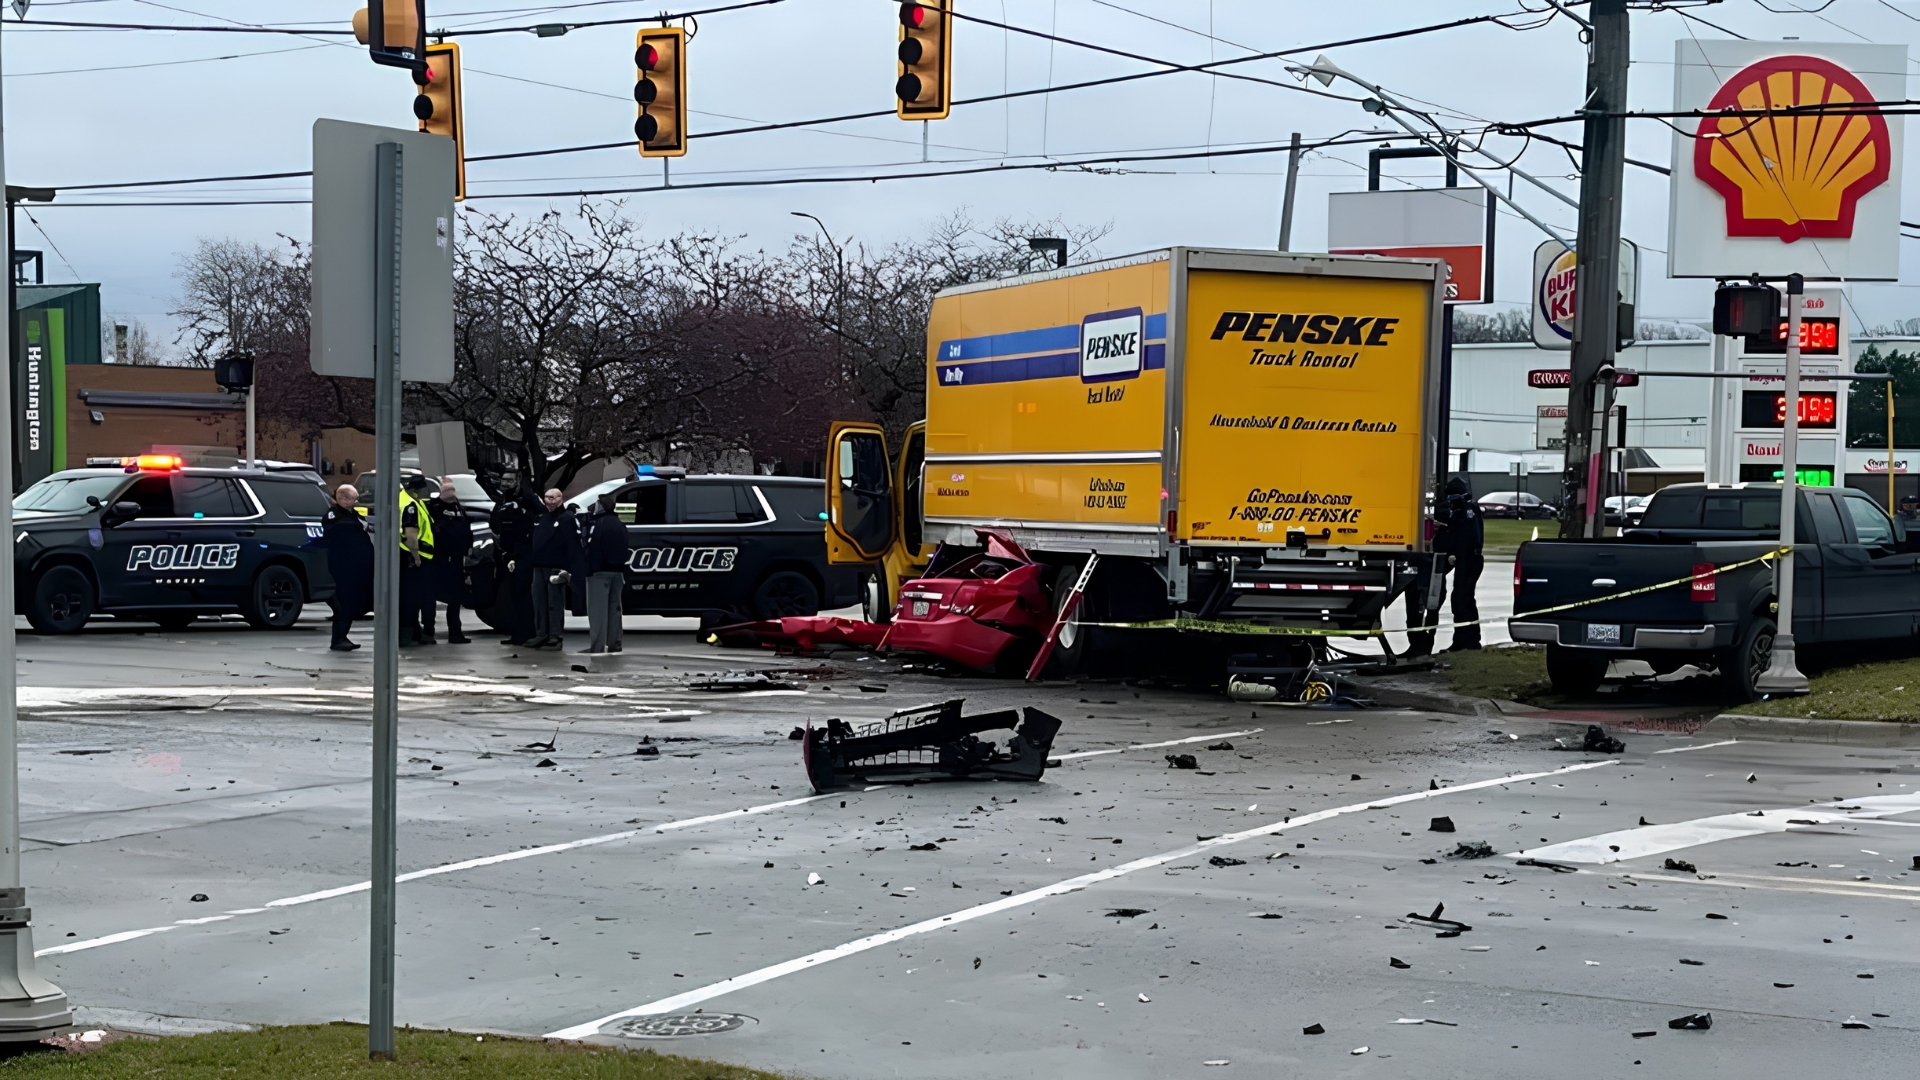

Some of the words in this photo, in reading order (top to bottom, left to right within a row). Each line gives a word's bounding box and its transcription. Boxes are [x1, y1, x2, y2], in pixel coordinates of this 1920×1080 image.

[1209, 311, 1400, 346] PENSKE
[1085, 331, 1138, 361] PENSKE
[126, 543, 240, 571] POLICE
[624, 546, 738, 572] OLICE
